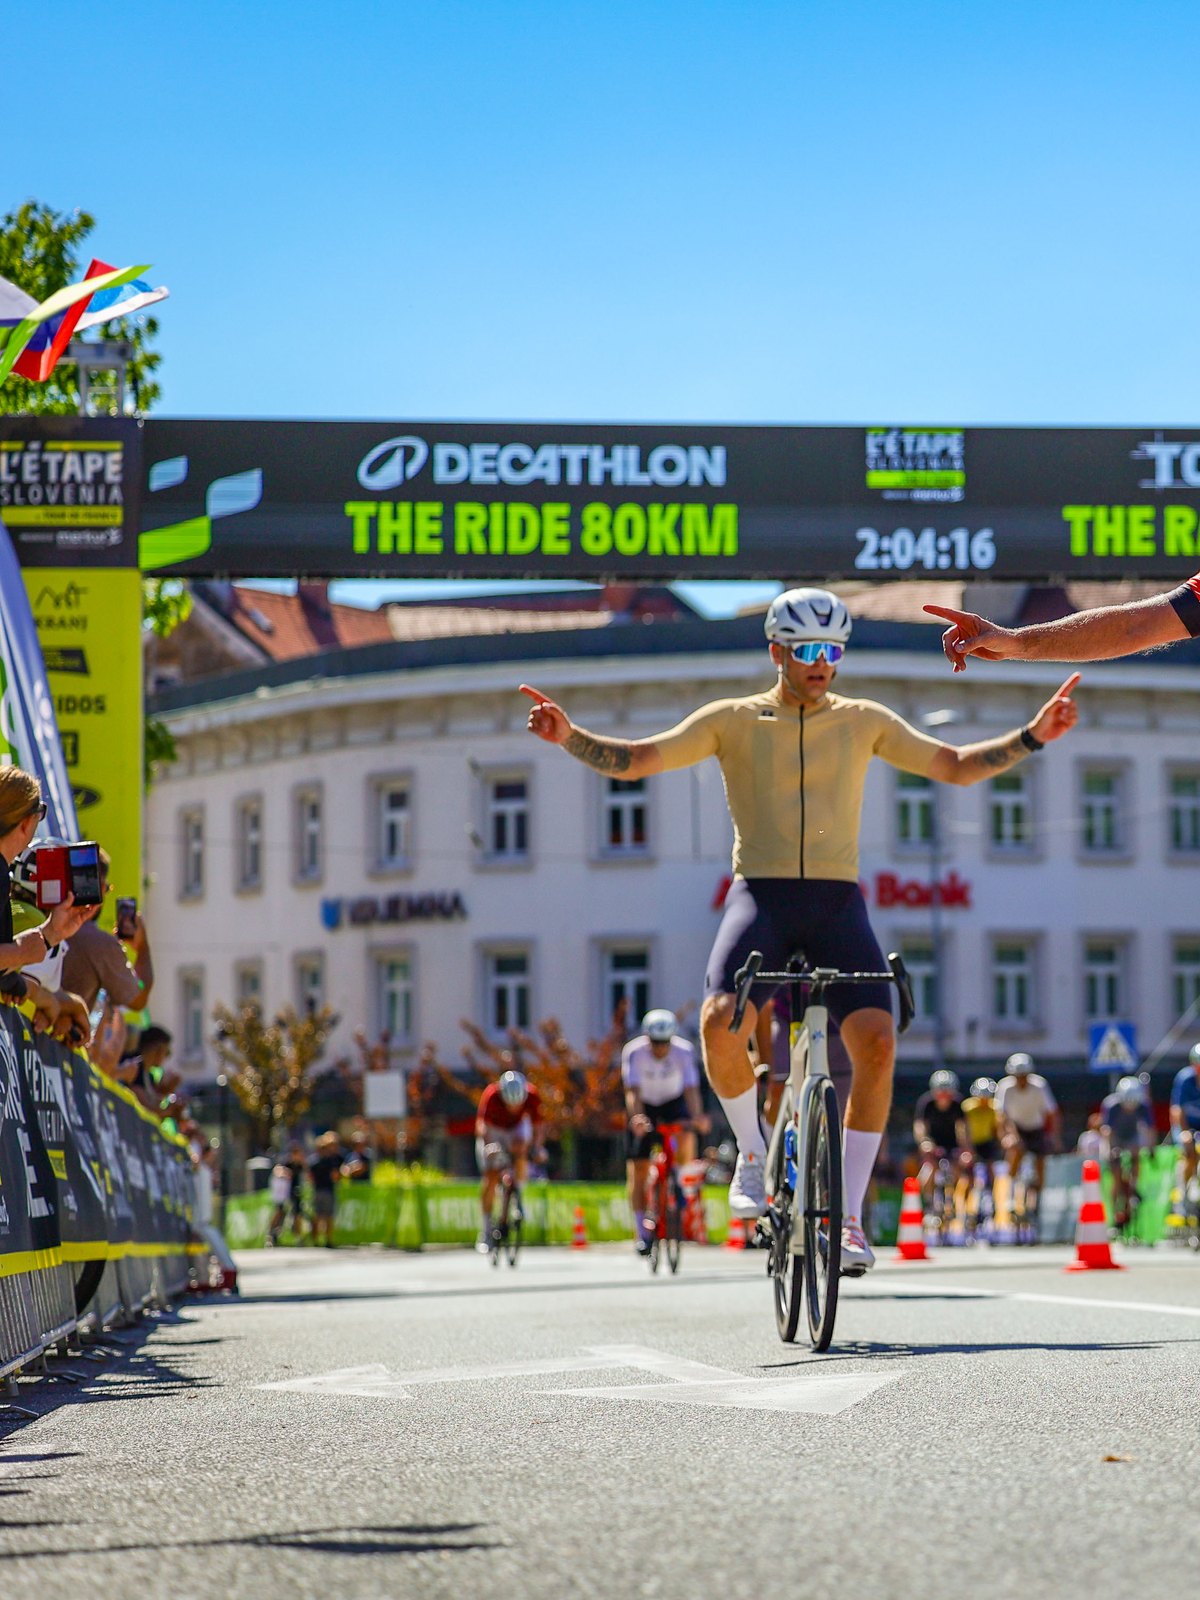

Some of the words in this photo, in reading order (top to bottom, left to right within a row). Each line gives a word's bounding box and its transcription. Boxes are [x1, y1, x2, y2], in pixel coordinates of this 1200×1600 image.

[0, 441, 123, 483] L'ÉTAPE
[433, 443, 726, 486] DECATHLON
[0, 483, 124, 505] SLOVENIA
[344, 501, 443, 554] THE
[454, 501, 571, 555] RIDE
[580, 502, 739, 556] 80KM
[854, 527, 997, 570] 2:04:16
[1062, 505, 1156, 556] THE
[57, 695, 106, 714] IDOS
[875, 868, 973, 908] Bank
